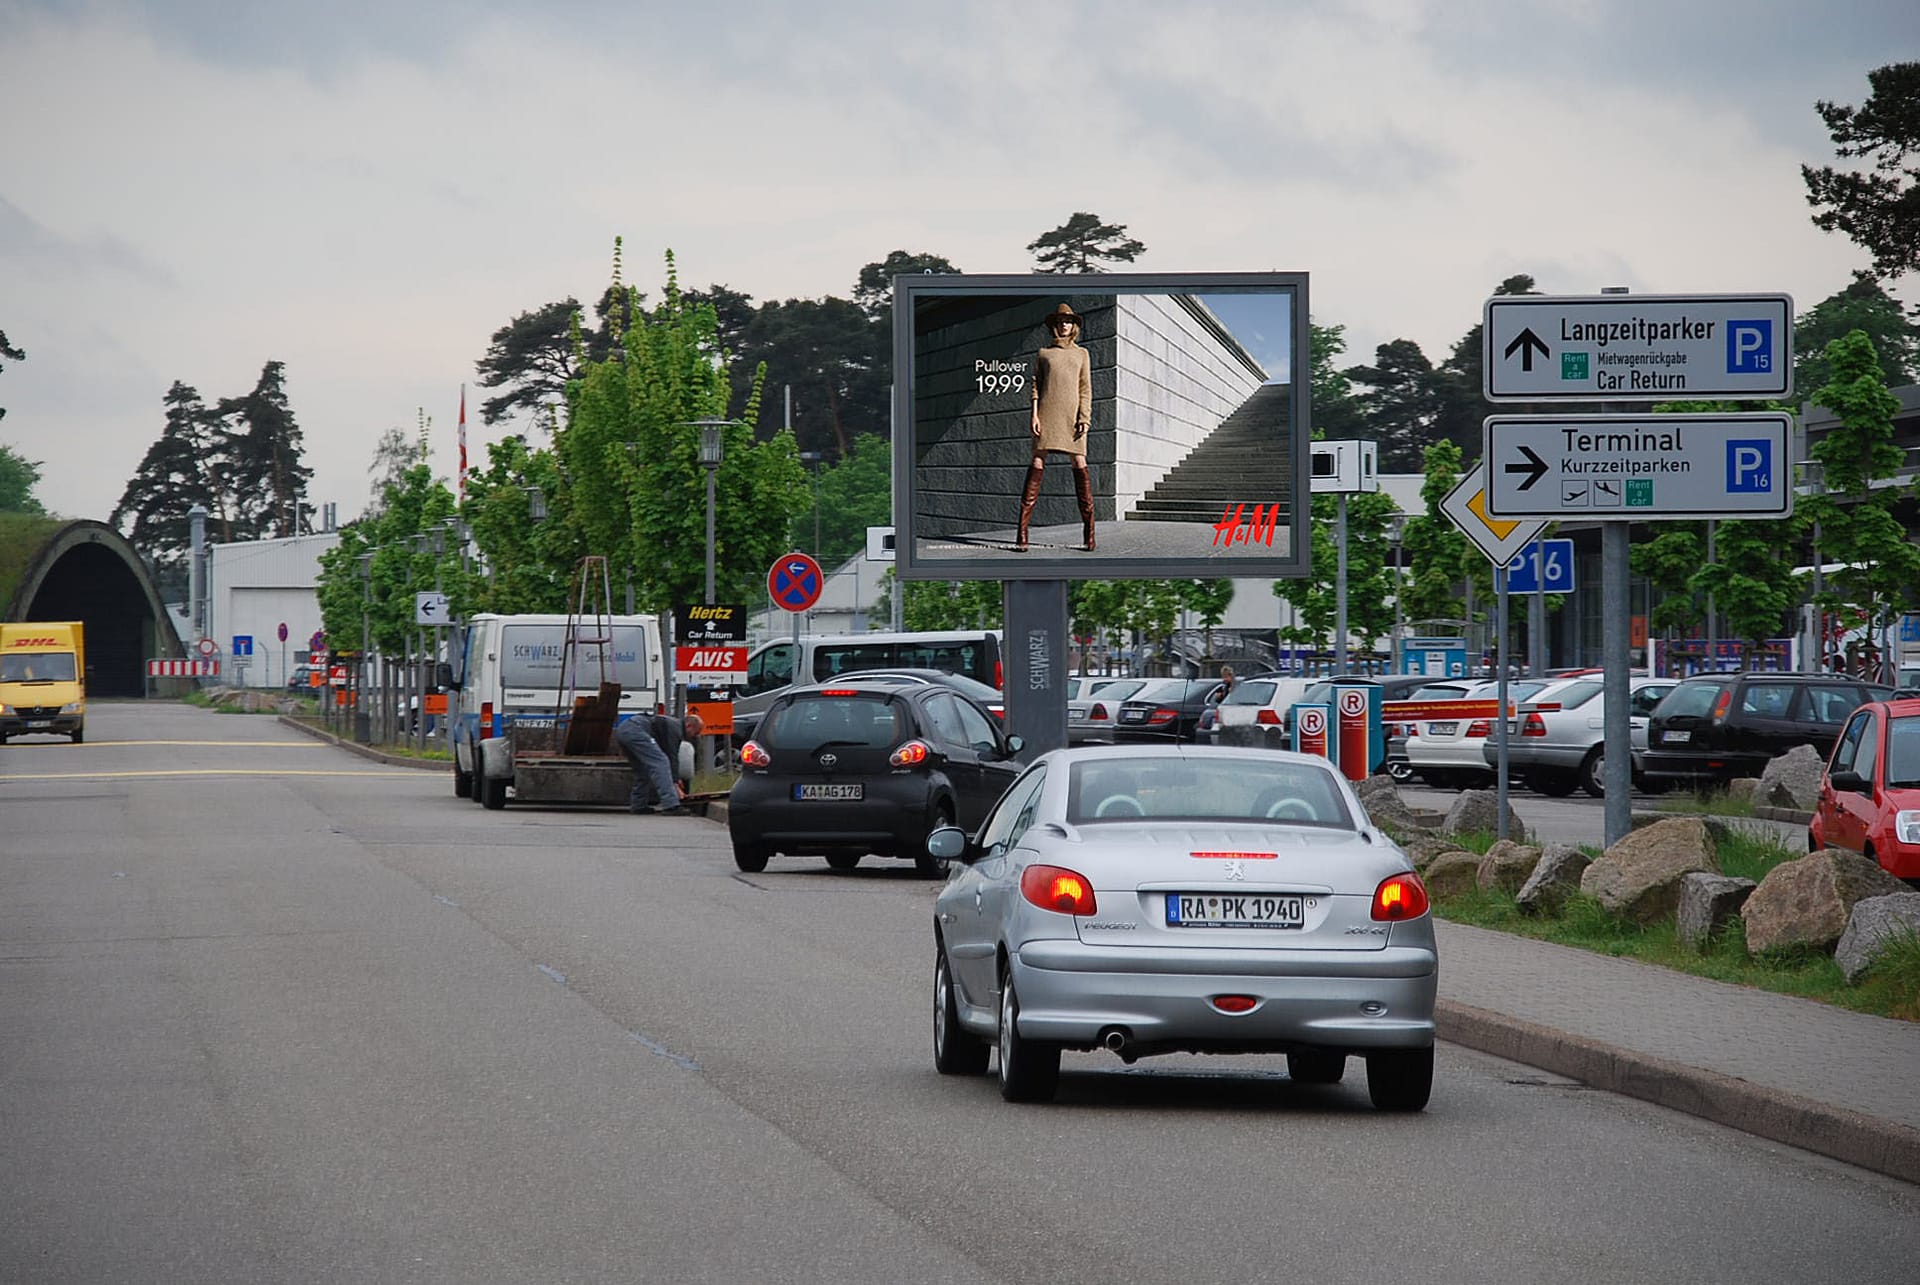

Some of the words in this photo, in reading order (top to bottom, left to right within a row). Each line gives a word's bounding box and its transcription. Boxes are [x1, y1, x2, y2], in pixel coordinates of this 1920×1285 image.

[1561, 317, 1715, 346] Langzeitparker
[1735, 328, 1763, 366] P
[1753, 355, 1769, 368] 15
[975, 359, 1028, 372] Pullover
[1564, 354, 1586, 363] Rent
[1597, 351, 1687, 368] Mietwagenrückgabe
[975, 374, 1025, 396] 19,99
[1597, 370, 1625, 390] Car
[1630, 370, 1686, 389] Return
[1561, 428, 1683, 451] Terminal
[1561, 459, 1691, 476] Kurzzeitparken
[1735, 448, 1762, 485] P
[1753, 474, 1768, 488] 16
[1628, 481, 1650, 489] Rent
[1212, 502, 1280, 548] H&M
[688, 606, 733, 620] Hertz
[15, 638, 57, 647] DHL
[688, 630, 702, 639] Car
[704, 631, 733, 639] Return
[513, 645, 560, 660] SCHWARZ
[689, 651, 735, 668] AVIS
[1030, 636, 1048, 690] SCHWARZ
[1346, 695, 1359, 709] R
[1307, 714, 1318, 728] R
[802, 786, 817, 798] KA
[824, 786, 838, 798] AG
[840, 786, 861, 798] 178
[1181, 898, 1206, 919] RA
[1222, 899, 1247, 920] PK
[1252, 899, 1300, 920] 1940
